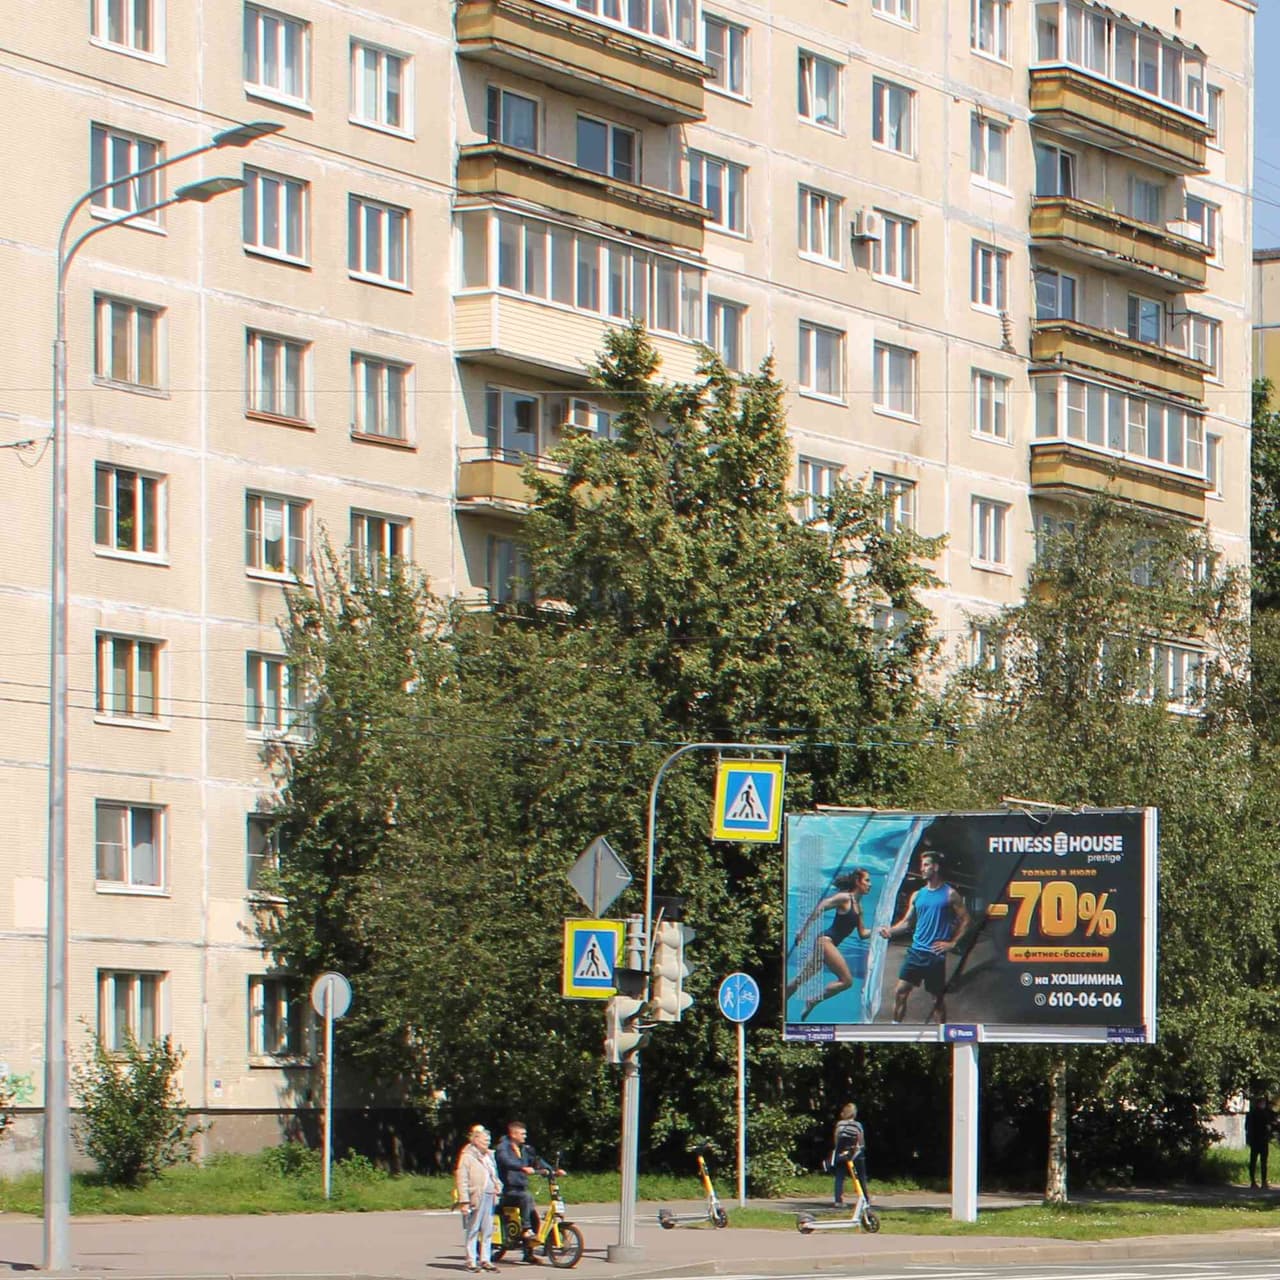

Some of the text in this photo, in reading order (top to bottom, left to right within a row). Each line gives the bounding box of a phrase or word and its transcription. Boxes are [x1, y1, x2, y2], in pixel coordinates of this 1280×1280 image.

[988, 835, 1123, 853] FITNESS HOUSE
[1087, 853, 1122, 863] prestige
[1035, 973, 1123, 985] на ХОШИМИНА
[1048, 992, 1122, 1007] 610-06-06
